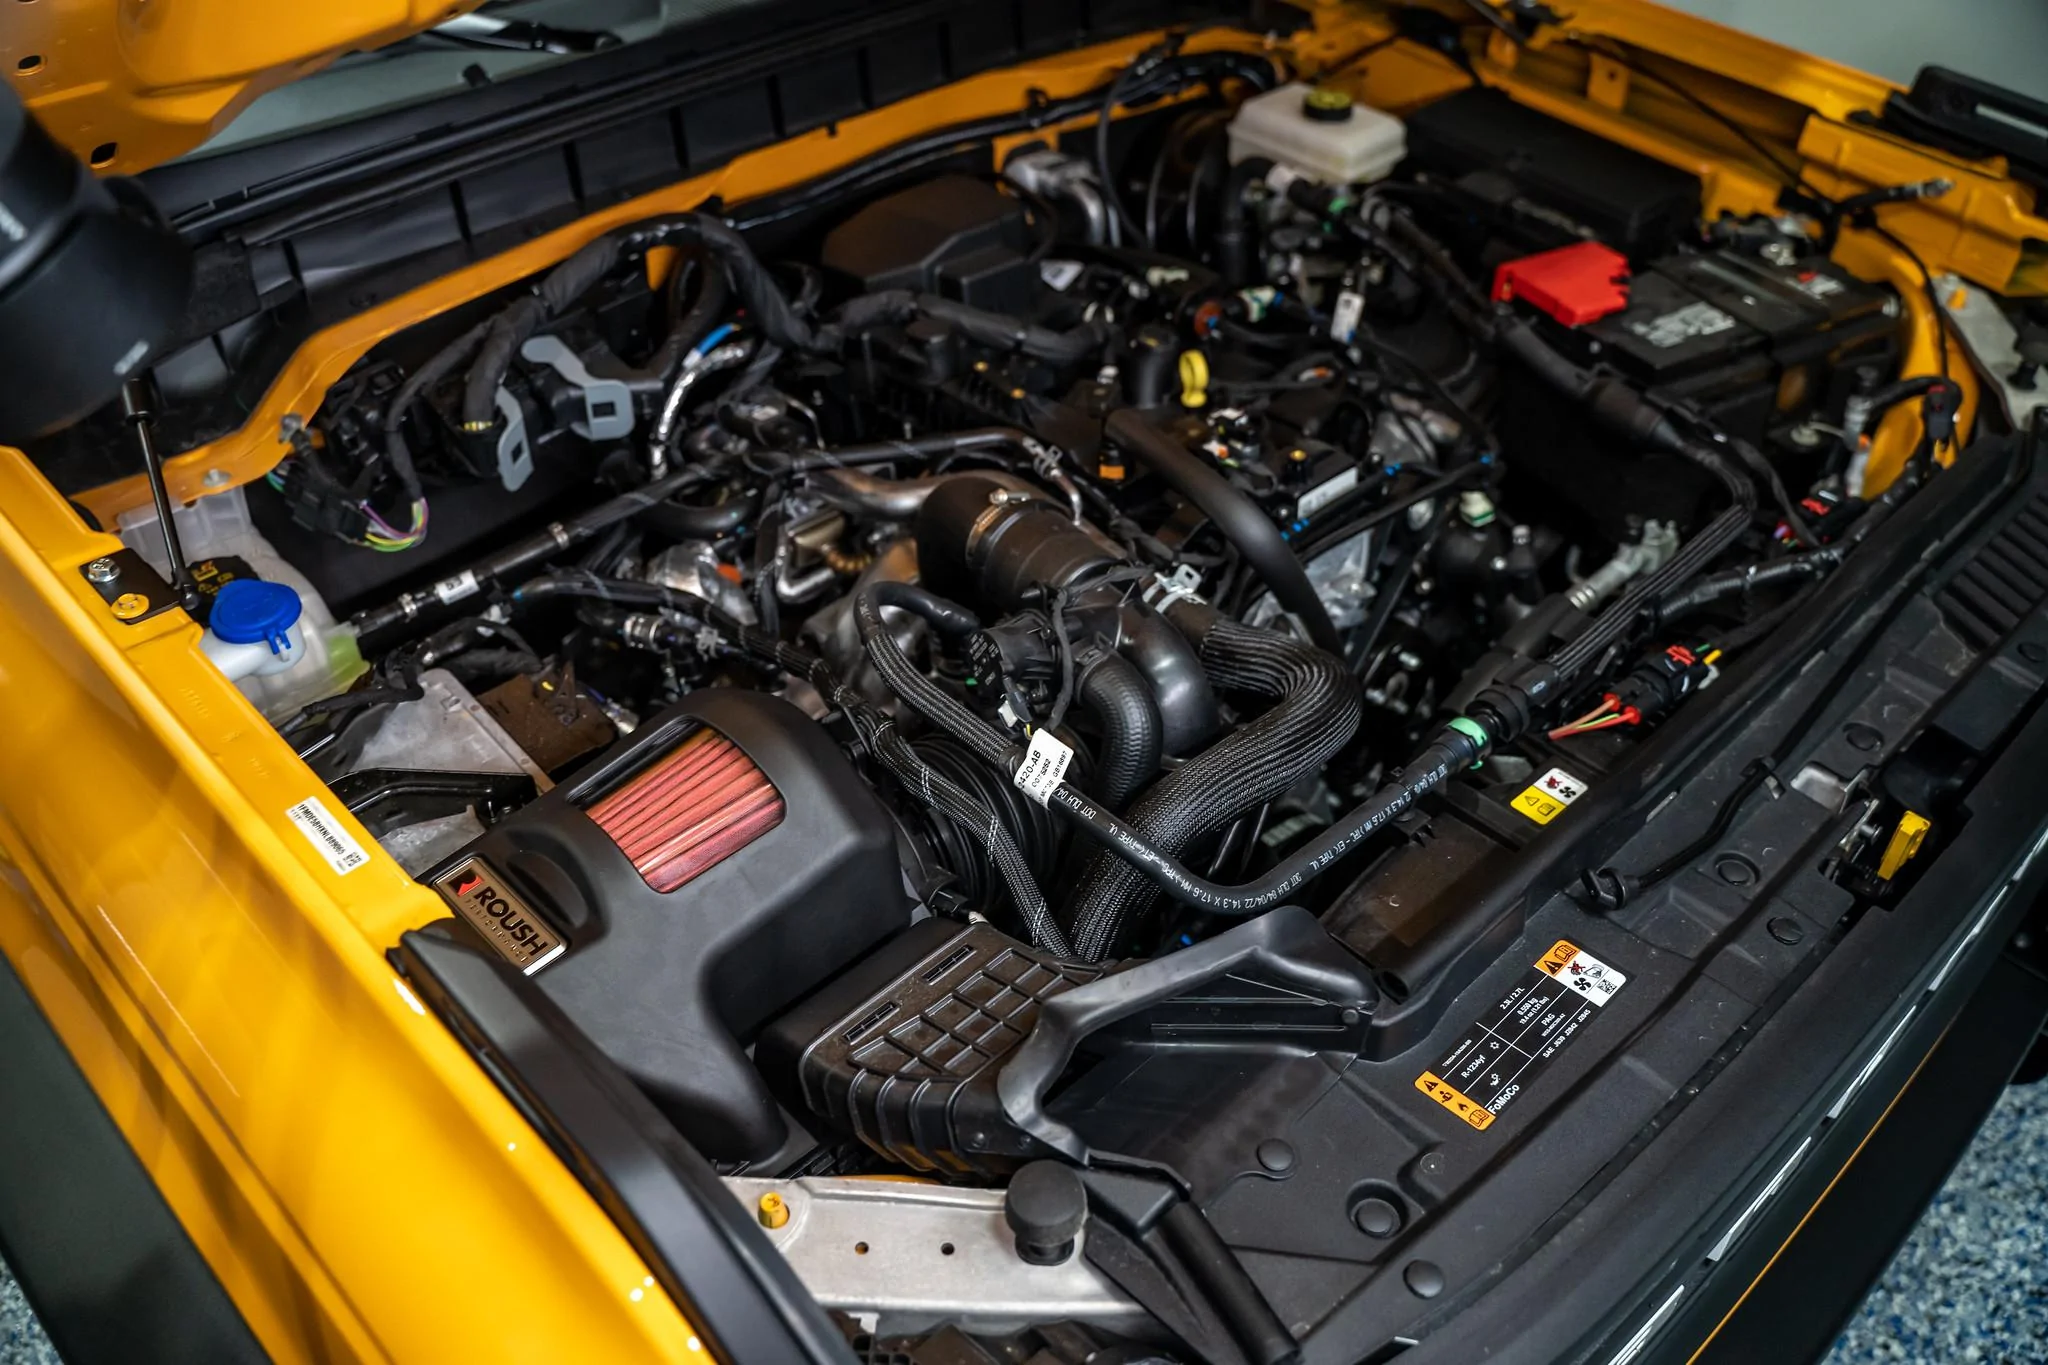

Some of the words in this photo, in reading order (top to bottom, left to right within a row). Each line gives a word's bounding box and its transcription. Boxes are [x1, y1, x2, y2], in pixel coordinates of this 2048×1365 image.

[1080, 805, 1098, 820] DOT
[1118, 831, 1138, 850] TYPE
[1192, 887, 1212, 903] 17.6
[1213, 896, 1221, 907] X
[1223, 897, 1242, 910] 14.3
[474, 886, 548, 956] ROUSH
[1541, 1013, 1556, 1026] PAG
[1542, 1046, 1556, 1058] SAE
[1460, 1054, 1486, 1079] R-1234yf
[1487, 1084, 1520, 1114] FoMoCo
